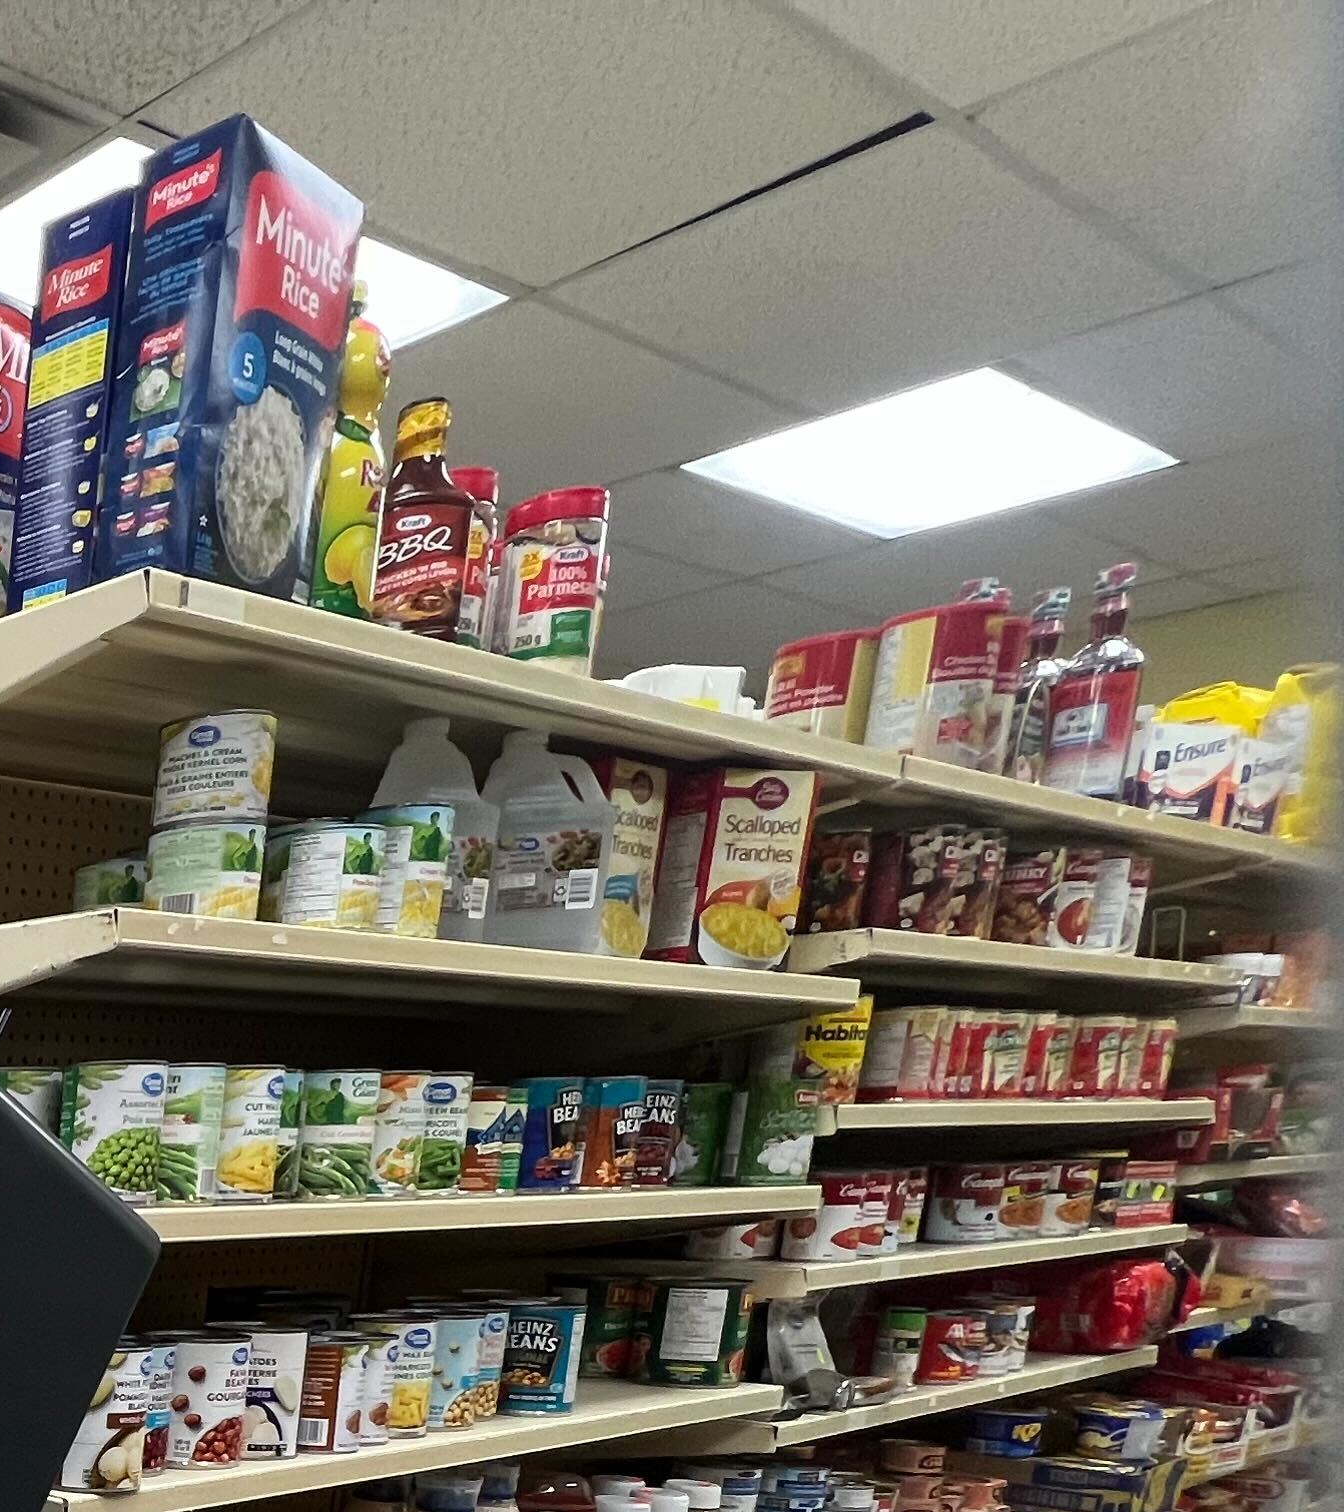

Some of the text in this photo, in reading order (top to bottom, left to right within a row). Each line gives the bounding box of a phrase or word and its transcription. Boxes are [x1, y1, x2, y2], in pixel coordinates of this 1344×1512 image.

[255, 193, 342, 294] Minute
[47, 258, 104, 295] Minute
[56, 283, 88, 308] Rice
[280, 265, 320, 318] Rice
[243, 354, 254, 377] 5
[378, 526, 453, 570] BBQ
[559, 549, 585, 560] Kraft
[549, 566, 588, 583] 100%
[1174, 737, 1228, 764] Ensure
[725, 814, 801, 837] Scalloped
[725, 844, 793, 864] Tranches
[646, 1093, 676, 1110] EINZ
[512, 1336, 562, 1353] EANS
